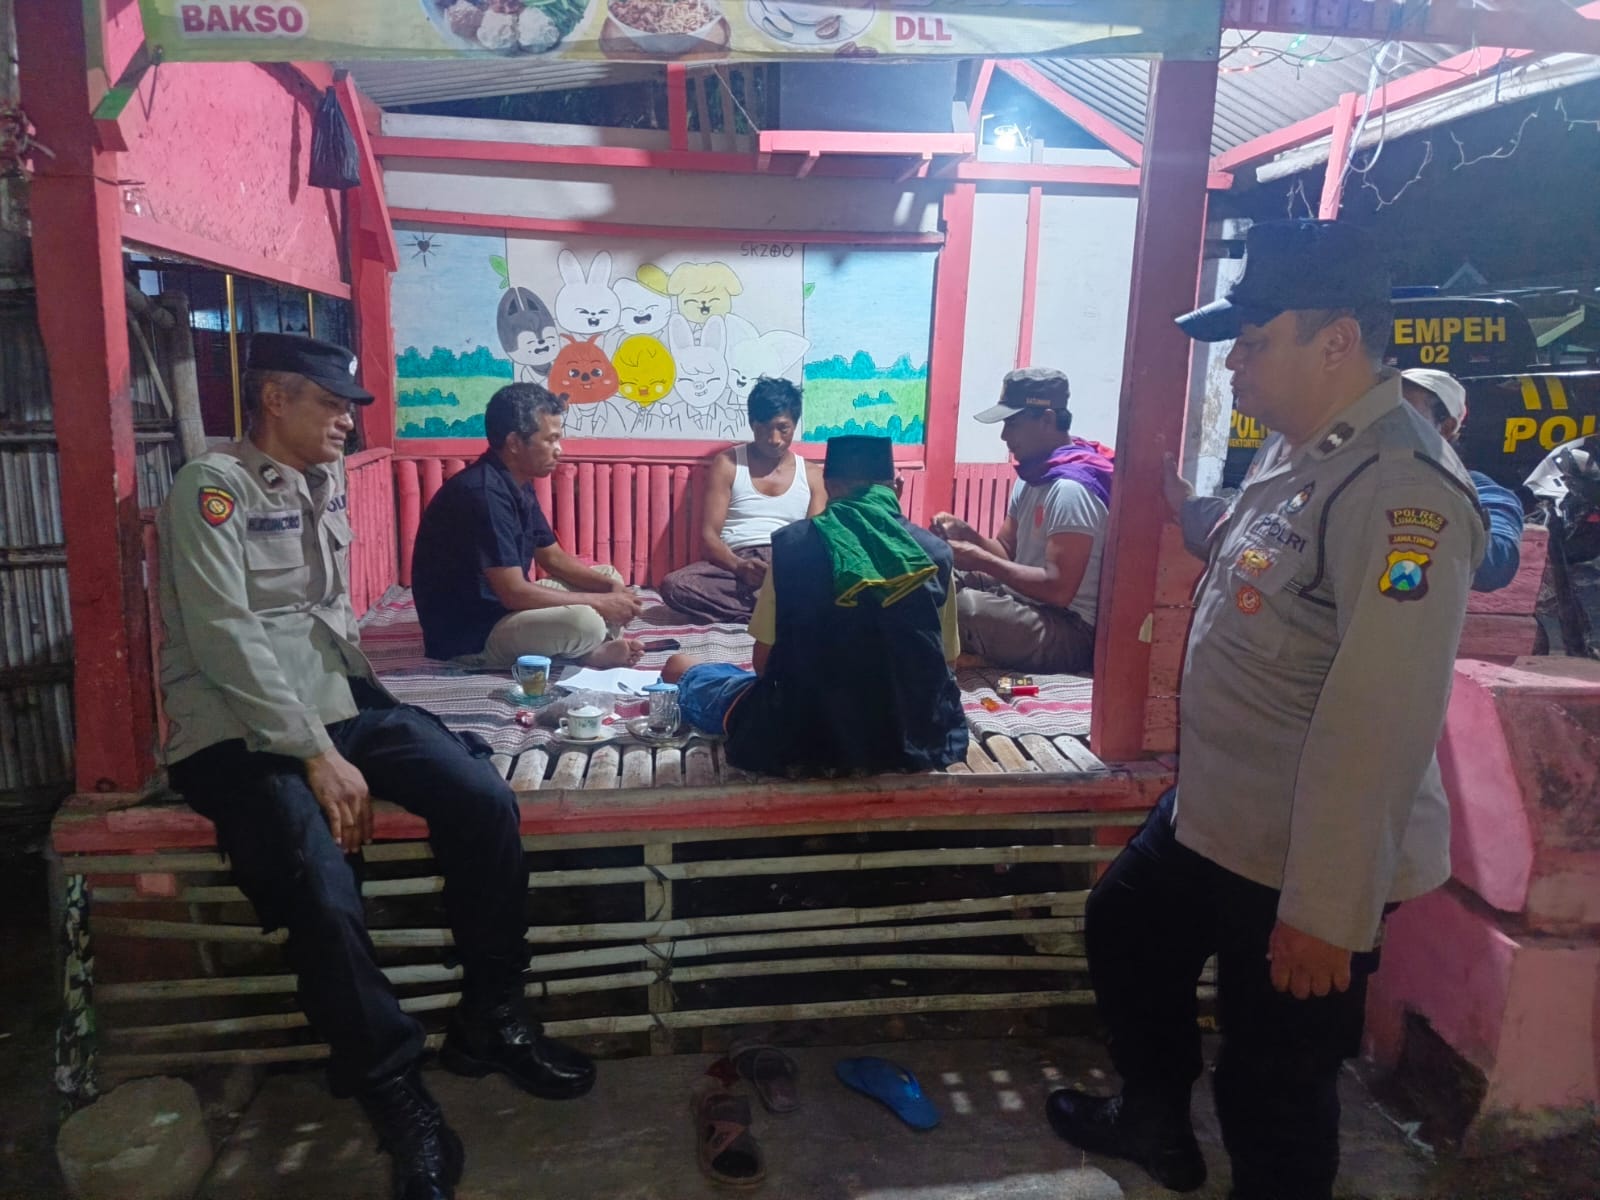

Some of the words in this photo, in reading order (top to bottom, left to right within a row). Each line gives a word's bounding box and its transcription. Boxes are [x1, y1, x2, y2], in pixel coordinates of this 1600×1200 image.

[181, 4, 304, 33] BAKSO
[895, 16, 952, 41] DLL
[1419, 345, 1450, 364] 02
